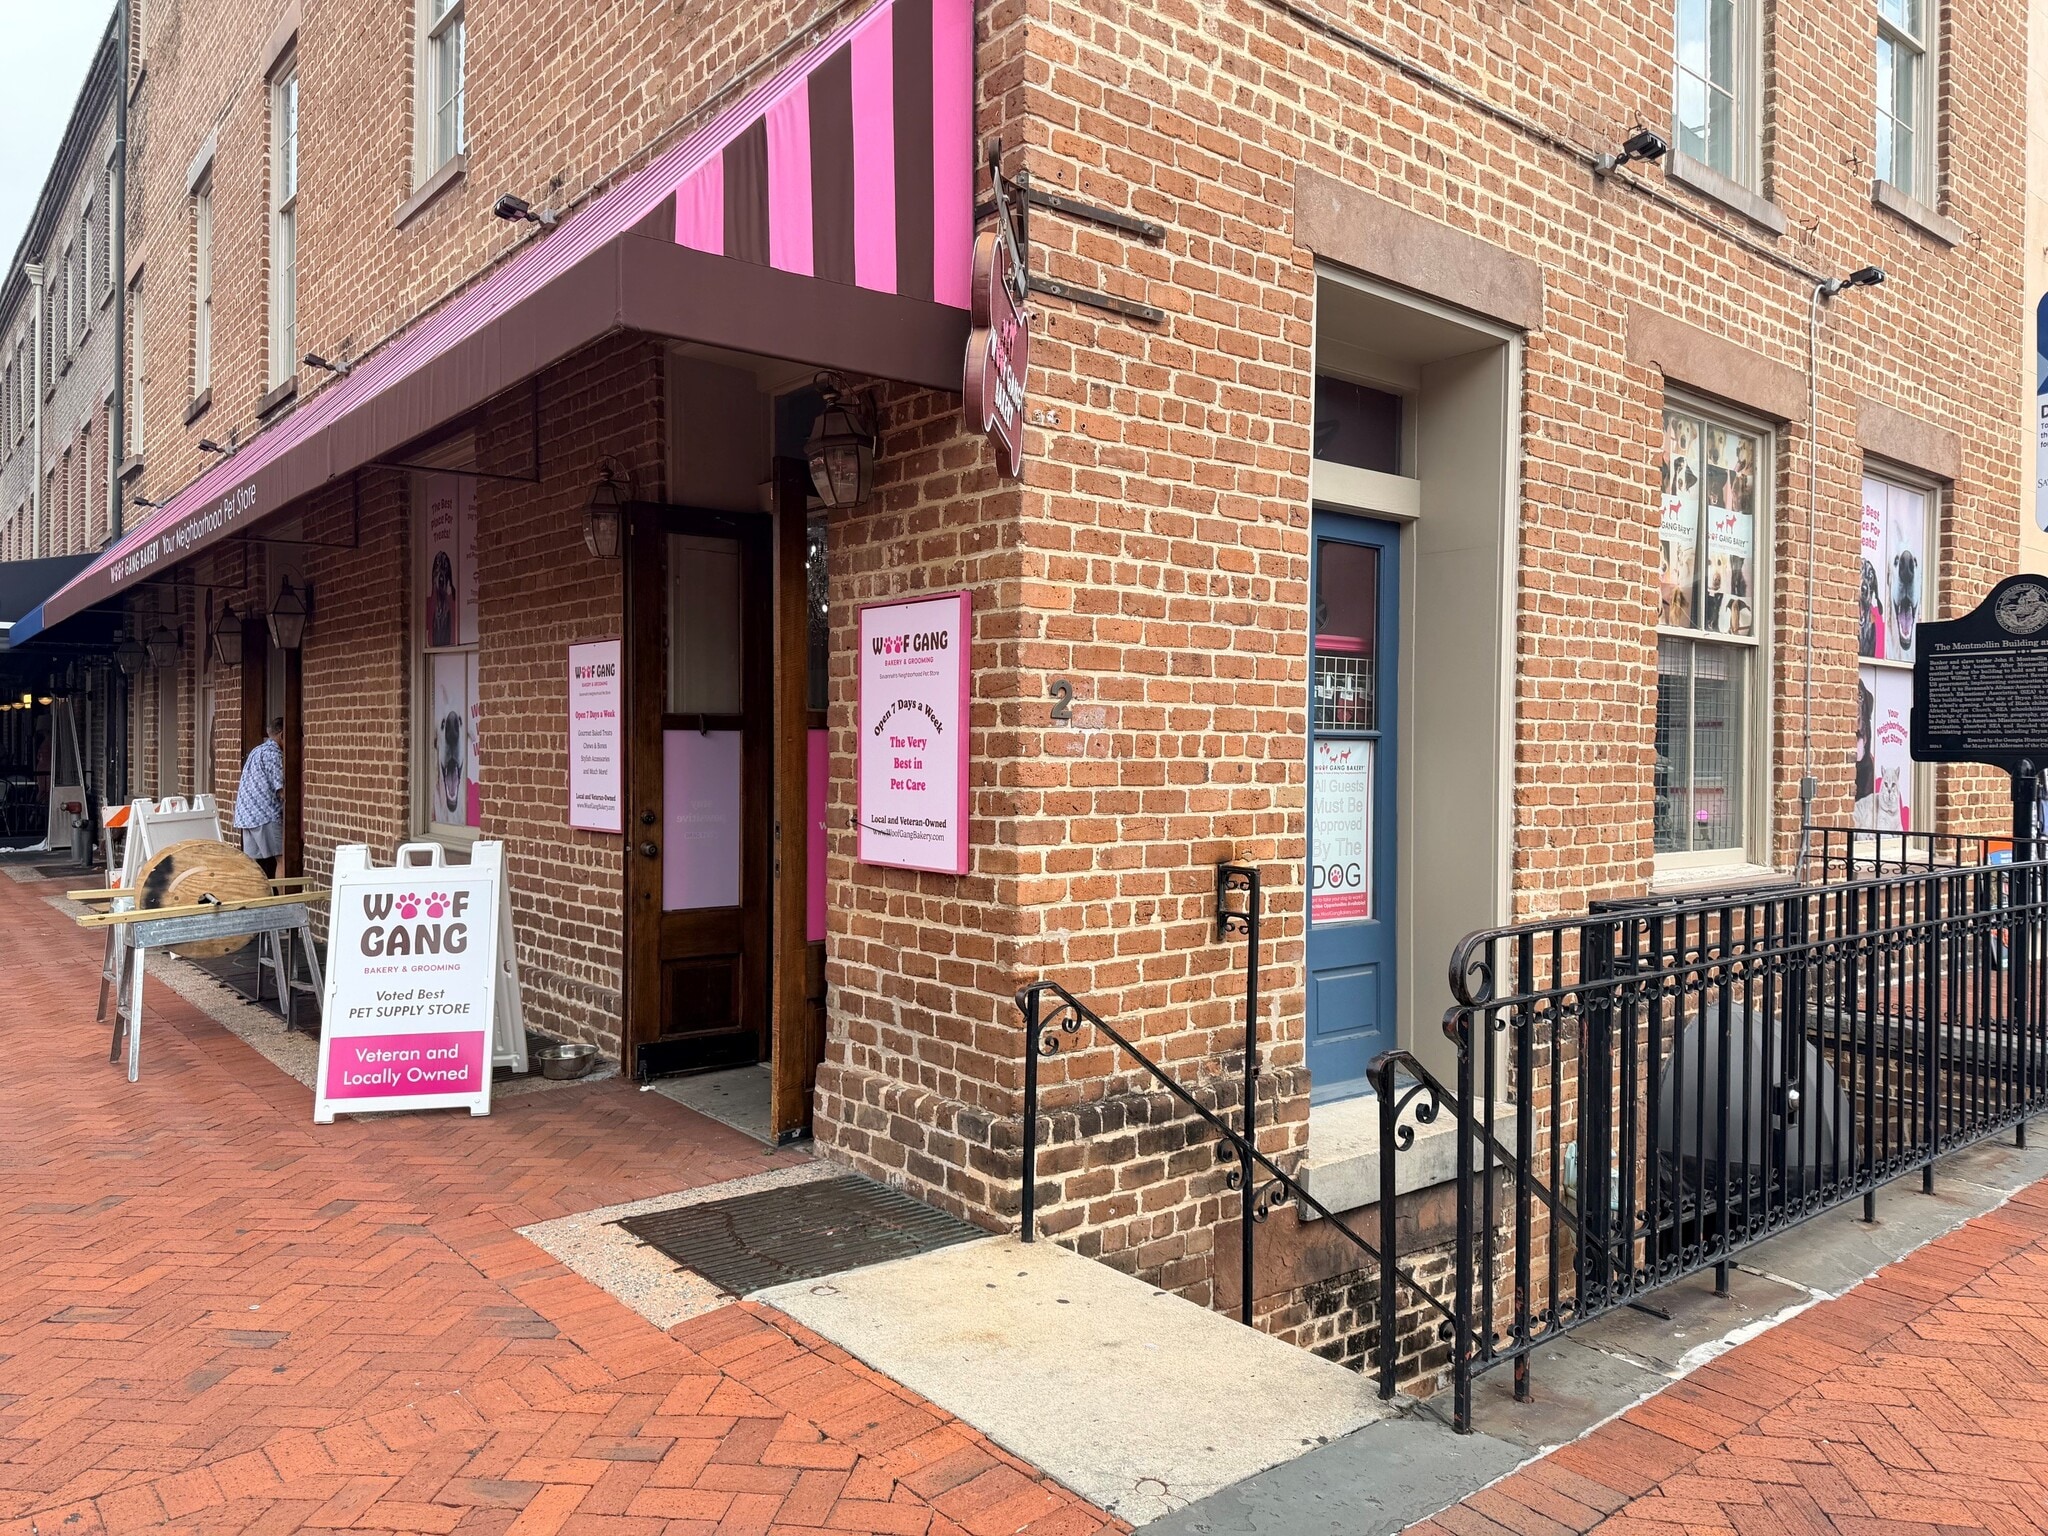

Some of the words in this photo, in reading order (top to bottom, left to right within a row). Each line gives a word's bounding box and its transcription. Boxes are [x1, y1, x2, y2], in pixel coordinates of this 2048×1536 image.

[1007, 364, 1022, 412] GANG
[432, 502, 440, 516] The
[440, 498, 452, 510] Best
[1866, 504, 1880, 522] Best
[445, 512, 453, 524] For
[1661, 521, 1677, 530] GANG
[124, 554, 140, 576] GANG
[140, 540, 159, 570] BAKERY
[162, 534, 175, 556] Your
[176, 508, 223, 550] Neighborhood
[224, 498, 235, 520] Pet
[236, 484, 256, 514] Store
[433, 528, 451, 544] Treats!
[1870, 522, 1880, 537] For
[1720, 534, 1732, 544] GANG
[1862, 537, 1877, 550] eats!
[913, 630, 948, 652] GANG
[1952, 640, 2000, 650] Montmollin
[2002, 636, 2039, 648] Building
[908, 656, 934, 665] GROOMING
[596, 663, 615, 678] GANG
[1050, 679, 1072, 720] 2
[575, 711, 586, 720] Open
[586, 710, 589, 719] 7
[590, 710, 599, 720] Days
[603, 710, 615, 718] Week
[874, 710, 892, 736] Open
[891, 702, 896, 714] 7
[897, 699, 916, 711] Days
[918, 702, 922, 711] a
[925, 704, 943, 735] Week
[1888, 709, 1899, 718] Your
[1877, 720, 1908, 738] Neighborhood
[890, 736, 905, 748] The
[907, 736, 927, 751] Very
[1882, 735, 1890, 745] Pet
[1891, 734, 1902, 745] Store
[894, 757, 912, 769] Best
[914, 756, 922, 769] in
[890, 778, 904, 790] Pet
[906, 778, 926, 791] Care
[1315, 780, 1326, 793] All
[1330, 779, 1364, 793] Guests
[1314, 797, 1344, 814] Must
[1348, 797, 1363, 813] Be
[871, 814, 886, 824] Local
[888, 816, 898, 824] and
[900, 816, 947, 828] Veteran-Owned
[1314, 817, 1362, 835] Approved
[1314, 838, 1331, 859] By
[1335, 838, 1362, 856] The
[1313, 863, 1360, 889] DOG
[360, 922, 468, 957] GANG
[364, 966, 399, 974] BAKERY
[411, 963, 461, 972] GROOMING
[376, 989, 414, 1001] Voted
[418, 988, 445, 1000] Best
[348, 1007, 372, 1019] PET
[376, 1005, 424, 1018] SUPPLY
[427, 1003, 470, 1015] STORE
[355, 1046, 420, 1063] Veteran
[426, 1043, 459, 1059] and
[344, 1067, 401, 1087] Locally
[406, 1066, 468, 1081] Owned
